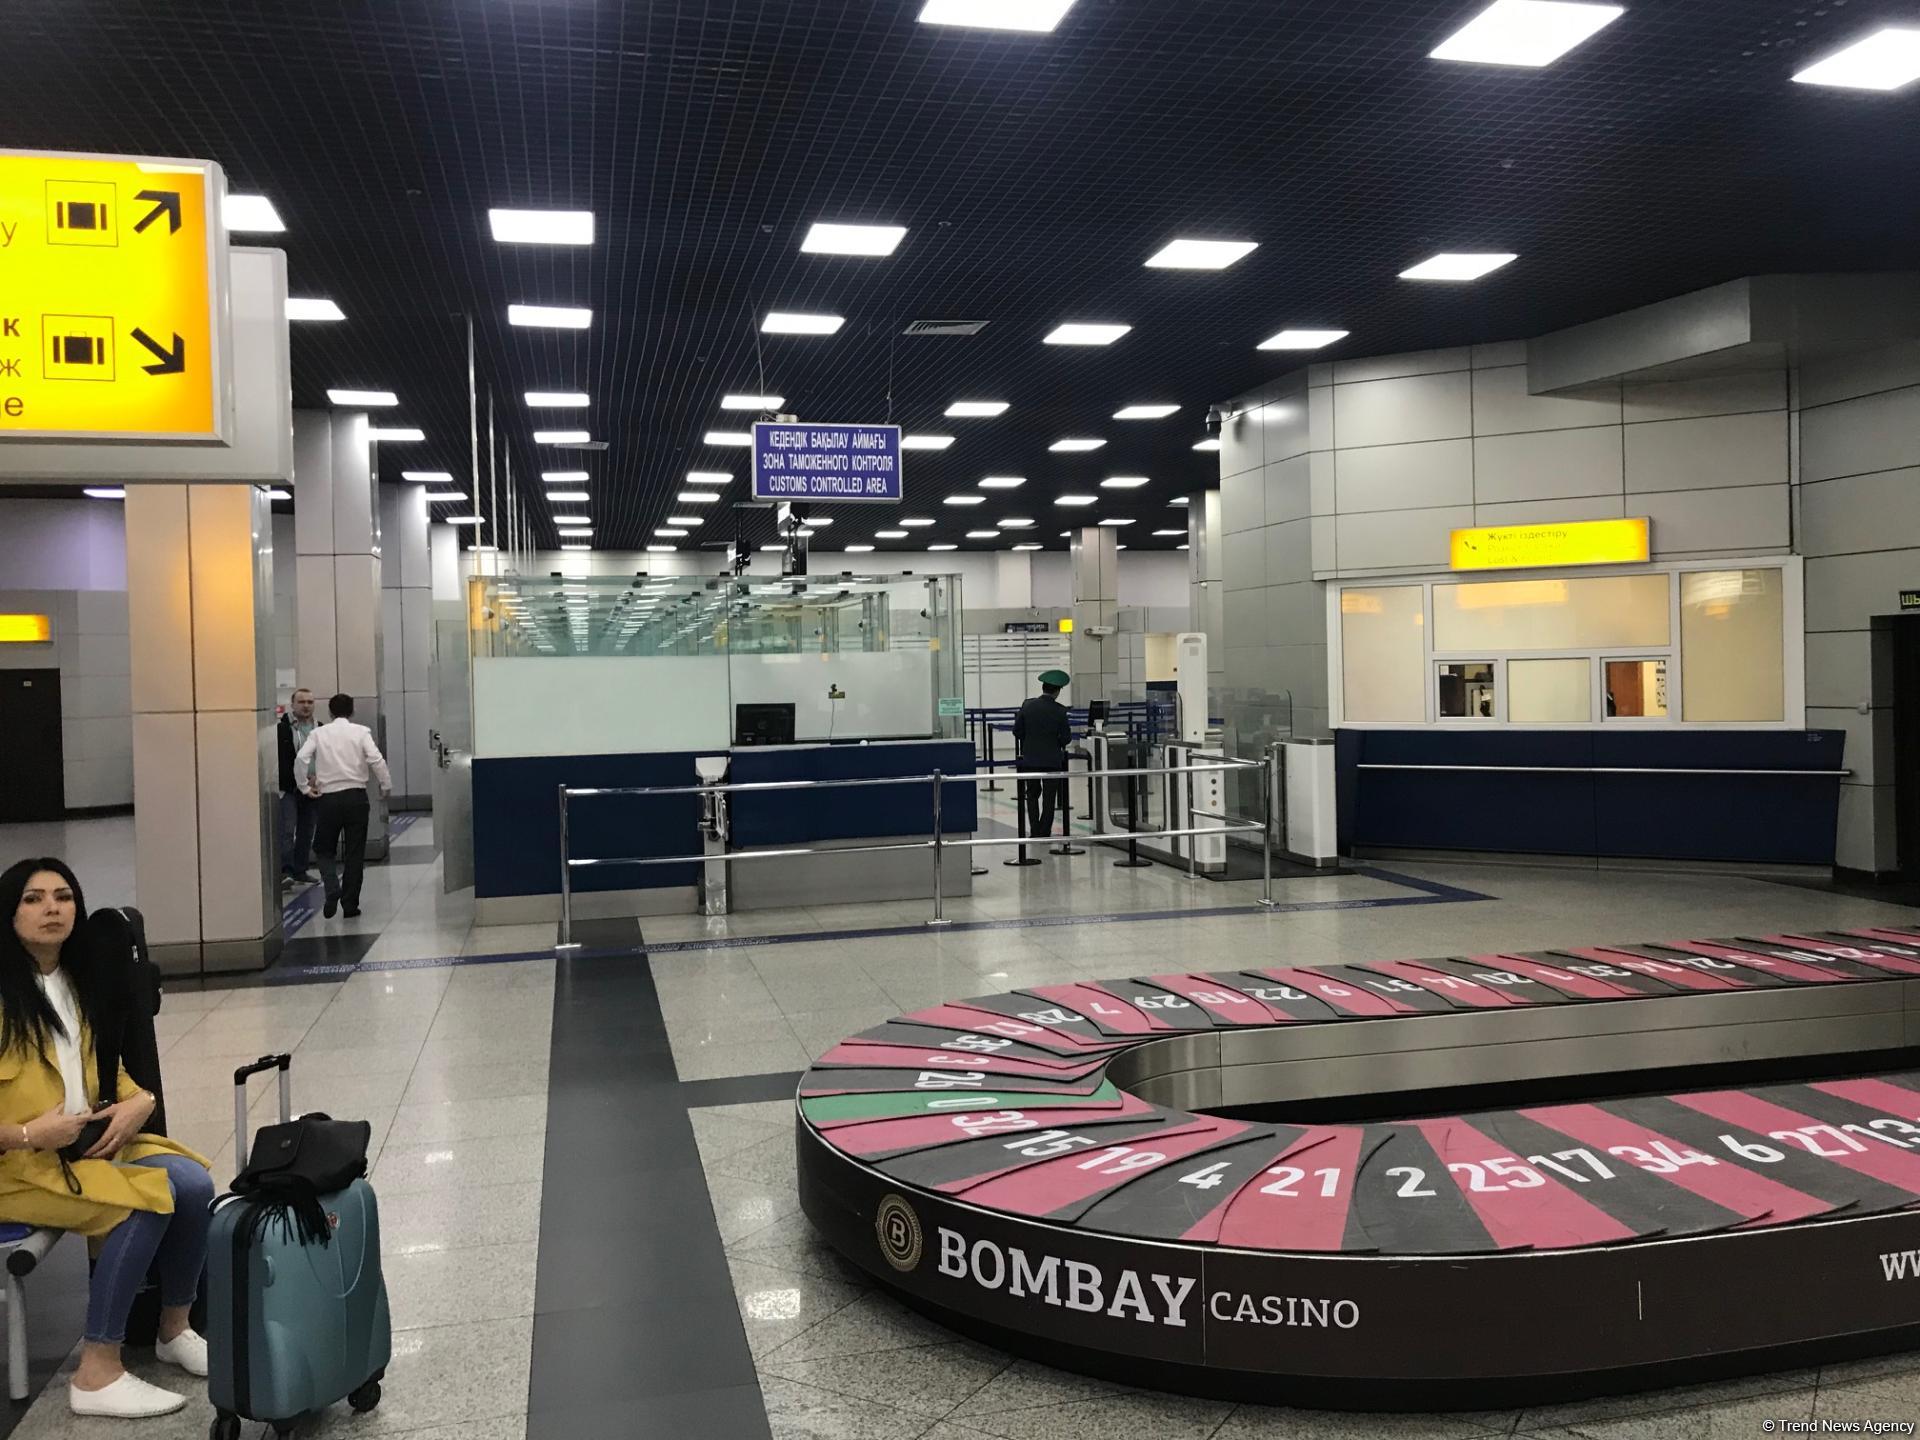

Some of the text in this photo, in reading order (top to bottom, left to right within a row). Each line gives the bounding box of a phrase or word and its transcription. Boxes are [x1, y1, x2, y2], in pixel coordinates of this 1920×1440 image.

[769, 429, 886, 451] КЕДЕНДІК БАҚЫЛАУ АЙМАҒЫ
[763, 453, 893, 471] ЗОНА ТАМОЖЕННОГО КОНТРОЛЯ
[769, 476, 888, 493] CUSTOMS CONTROLLED AREA
[1365, 979, 1424, 992] 31
[1472, 972, 1535, 985] 20
[1135, 994, 1190, 1009] 29
[1190, 990, 1249, 1004] 18
[1242, 986, 1307, 1001] 22
[1017, 1008, 1085, 1024] 28
[973, 1021, 1043, 1036] 12
[928, 1056, 989, 1065] 3
[915, 1071, 985, 1088] 26
[927, 1097, 998, 1108] 0
[952, 1110, 1038, 1136] 32
[1003, 1129, 1097, 1157] 15
[1718, 1134, 1785, 1164] 6
[1769, 1124, 1868, 1157] 27
[1076, 1146, 1166, 1175] 19
[1527, 1147, 1616, 1184] 17
[1609, 1140, 1720, 1173] 34
[1178, 1161, 1232, 1190] 4
[1260, 1166, 1341, 1197] 21
[1385, 1166, 1437, 1198] 2
[1447, 1157, 1545, 1193] 25
[937, 1226, 1360, 1329] BOMBAY CASINO
